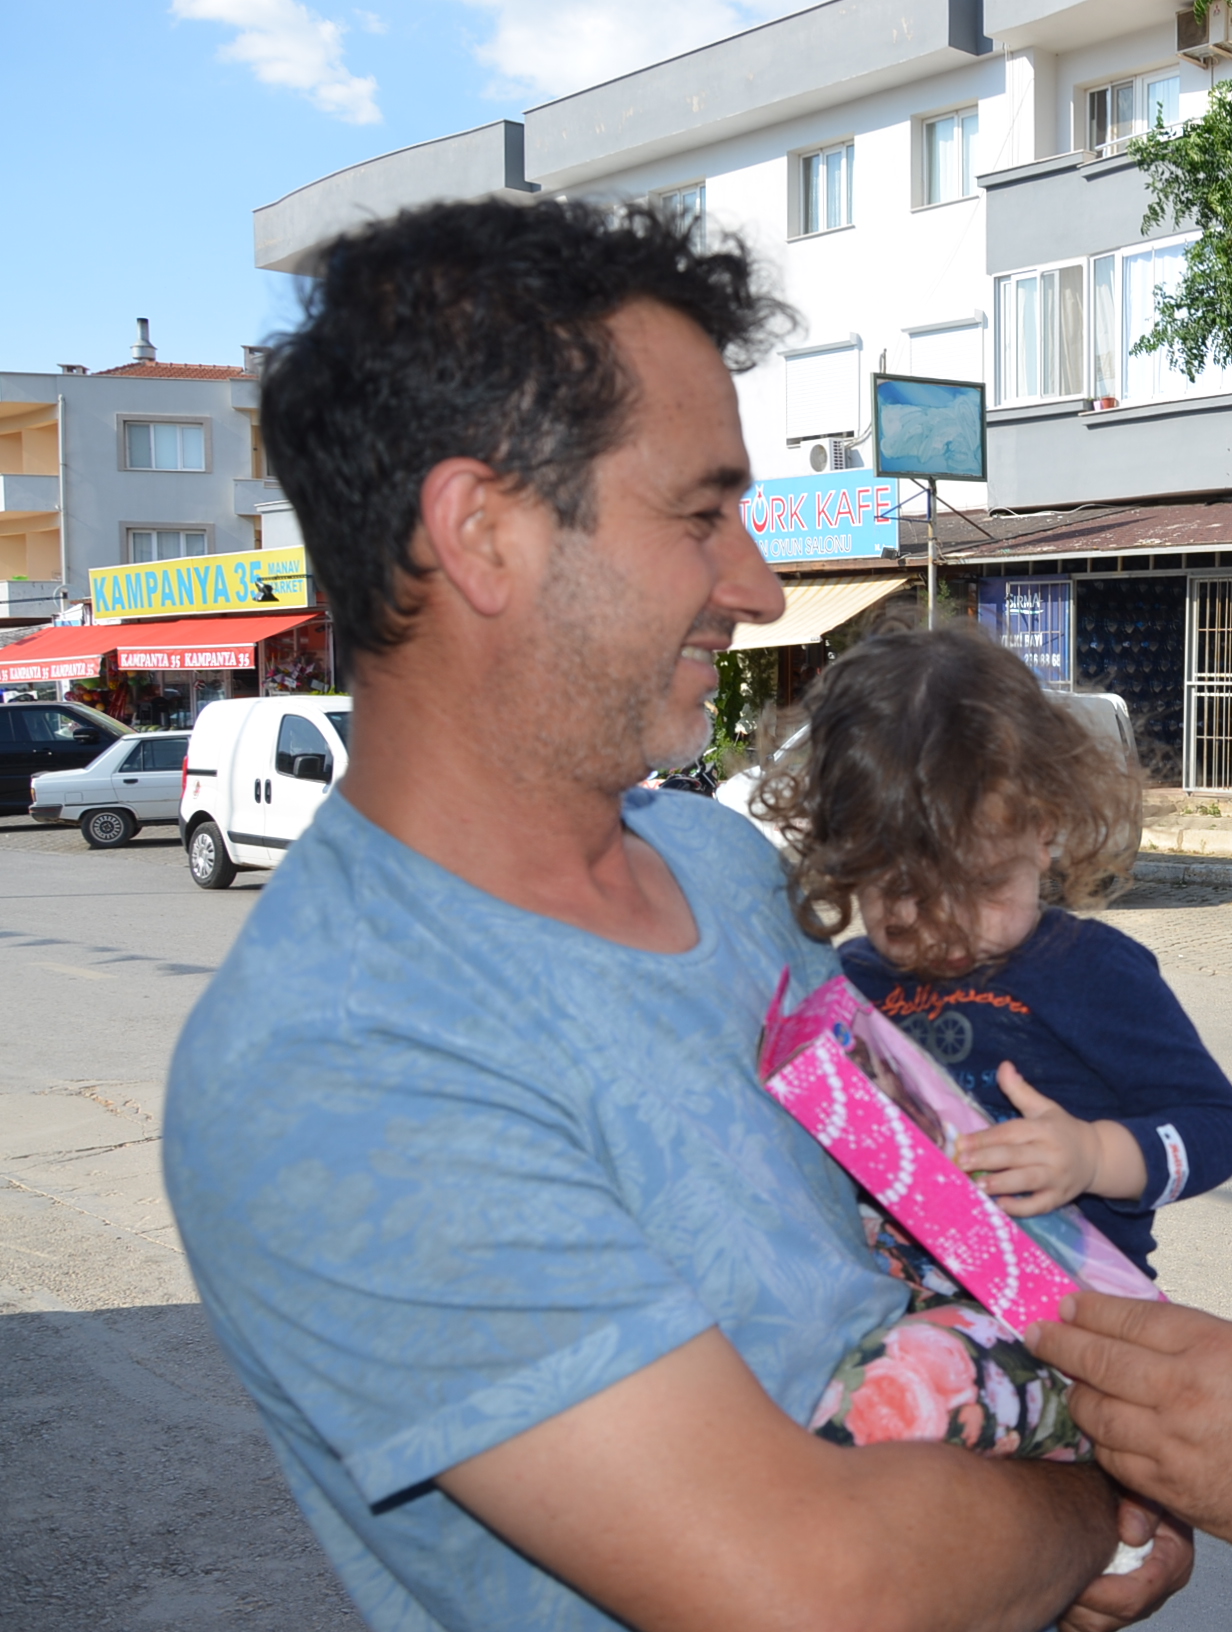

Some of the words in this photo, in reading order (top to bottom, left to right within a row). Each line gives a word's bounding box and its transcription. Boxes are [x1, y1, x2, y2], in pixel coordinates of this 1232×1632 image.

[815, 485, 891, 530] KAFE
[770, 537, 803, 557] OYUN
[805, 534, 852, 556] SALONU
[268, 560, 300, 575] MANAV
[93, 564, 231, 613] KAMPANYA
[269, 579, 304, 595] ARKET
[121, 653, 169, 667] KAMPANYA
[170, 655, 180, 668] 35
[184, 652, 236, 667] KAMPANYA
[238, 653, 250, 667] 35
[9, 666, 41, 680] KAMPANYA
[51, 663, 86, 678] KAMPANYA
